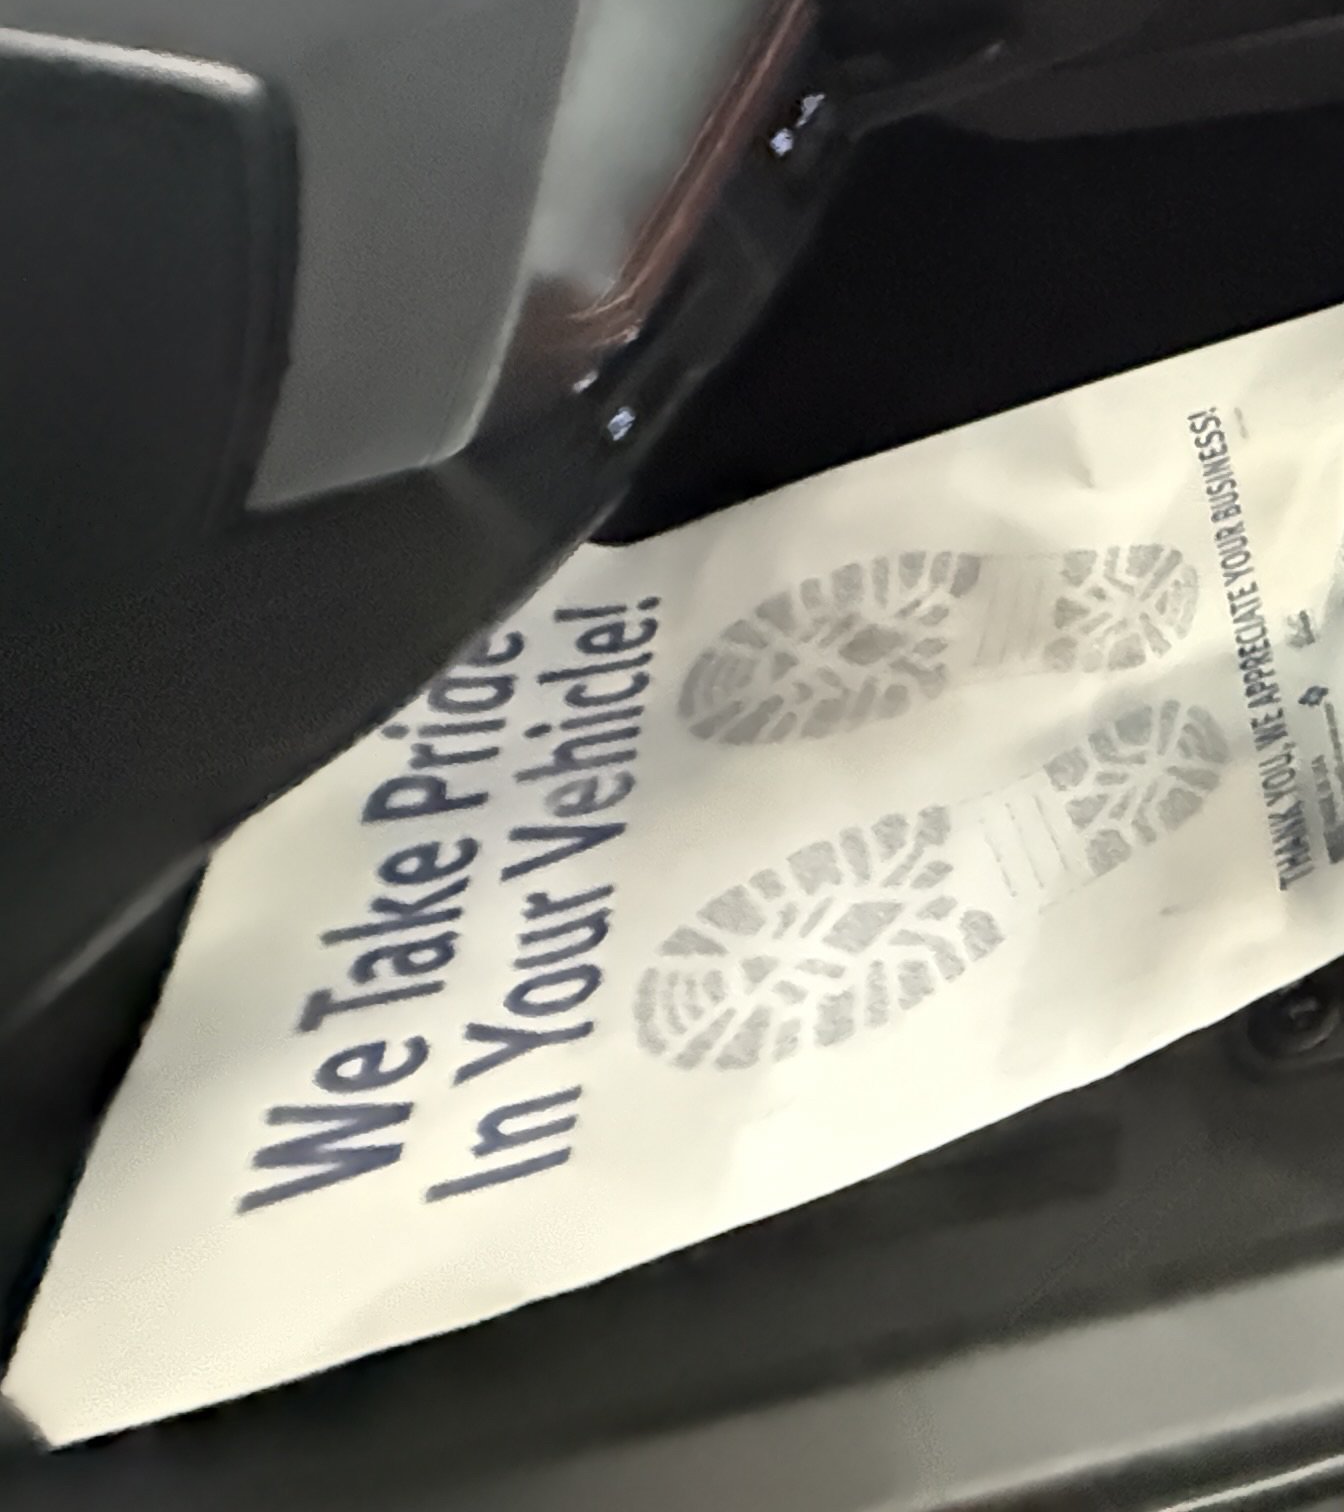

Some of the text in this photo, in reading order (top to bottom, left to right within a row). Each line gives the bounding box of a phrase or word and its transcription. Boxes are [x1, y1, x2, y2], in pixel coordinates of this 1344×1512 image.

[1187, 406, 1316, 891] THANK YOU, WE APPRECIATE YOUR BUSINESS!
[296, 837, 480, 1034] Take
[425, 596, 662, 1203] In Your Vehicle!
[236, 1035, 430, 1214] We
